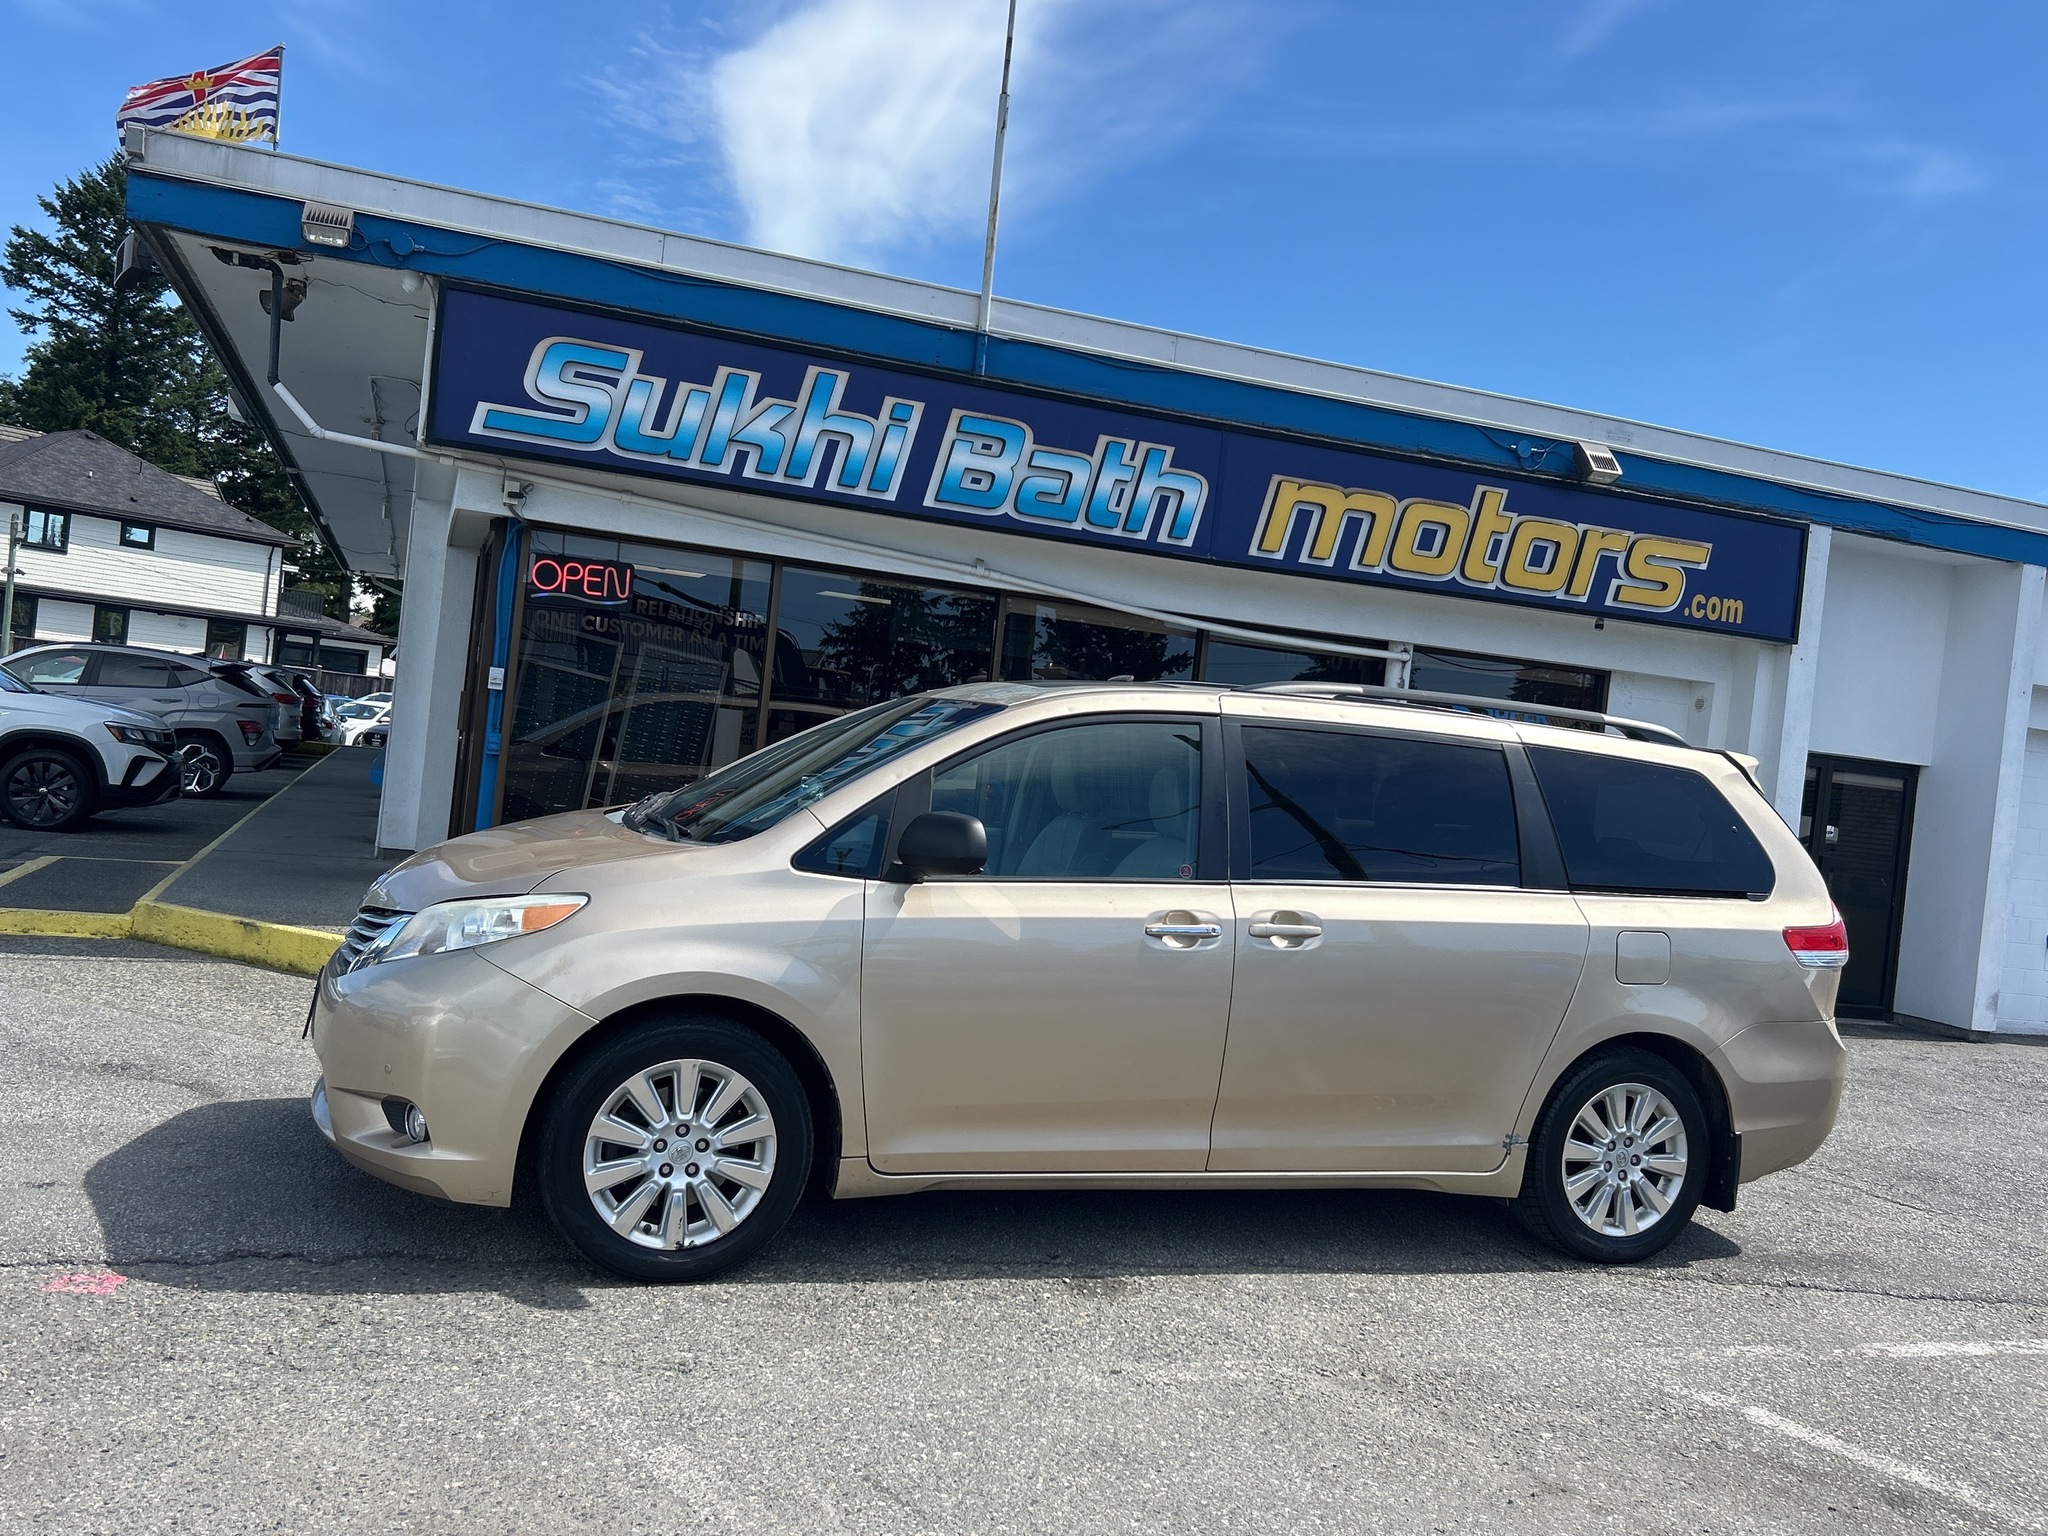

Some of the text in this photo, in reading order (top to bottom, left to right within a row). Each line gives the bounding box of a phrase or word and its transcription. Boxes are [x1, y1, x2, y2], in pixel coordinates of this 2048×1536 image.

[469, 336, 922, 502] Sukhi
[923, 408, 1210, 547] Bath
[1684, 592, 1744, 625] .com
[531, 559, 631, 599] OPEN
[535, 609, 576, 629] ONE
[581, 614, 684, 642] CUSTOMER
[717, 632, 728, 647] A
[733, 634, 766, 652] TIM
